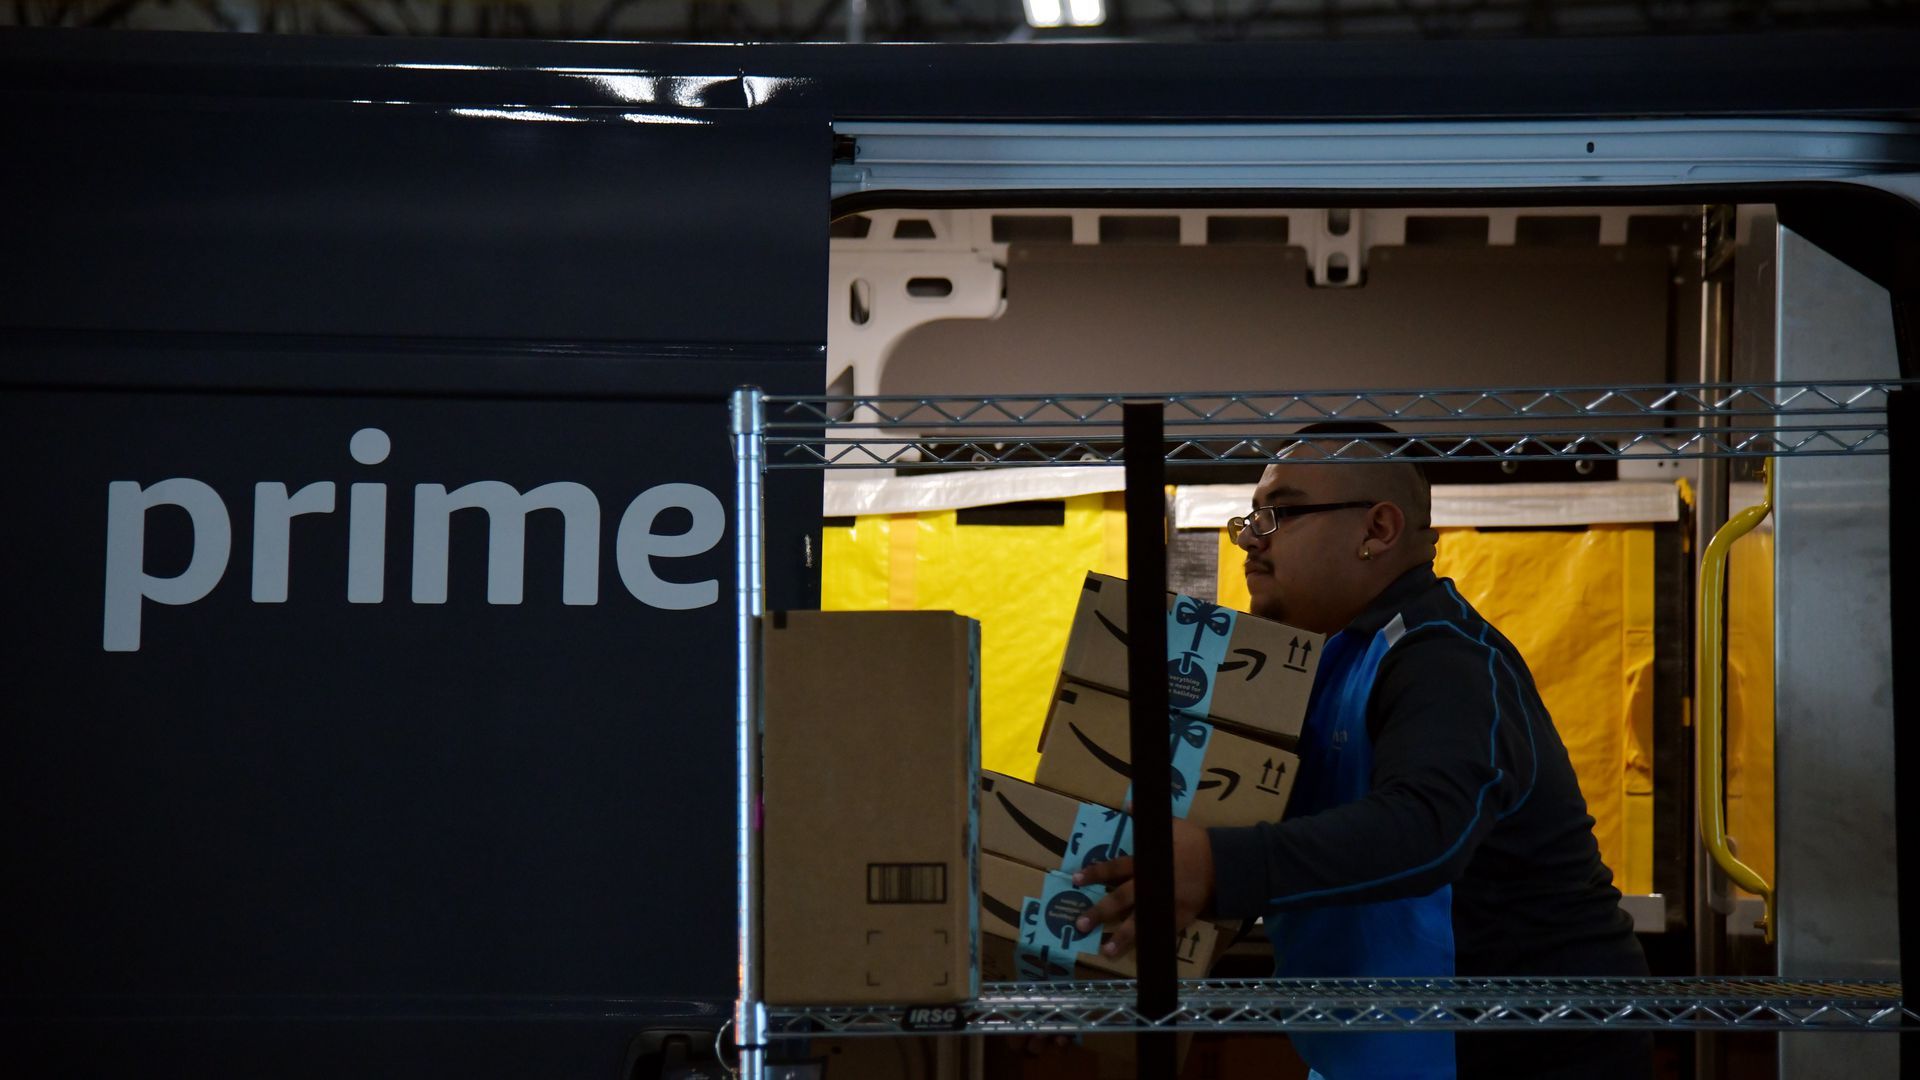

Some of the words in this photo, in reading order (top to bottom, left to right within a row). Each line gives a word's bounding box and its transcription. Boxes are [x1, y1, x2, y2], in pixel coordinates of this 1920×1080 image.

[104, 428, 726, 651] prime
[1168, 675, 1200, 687] verything
[909, 1007, 957, 1024] IRSG
